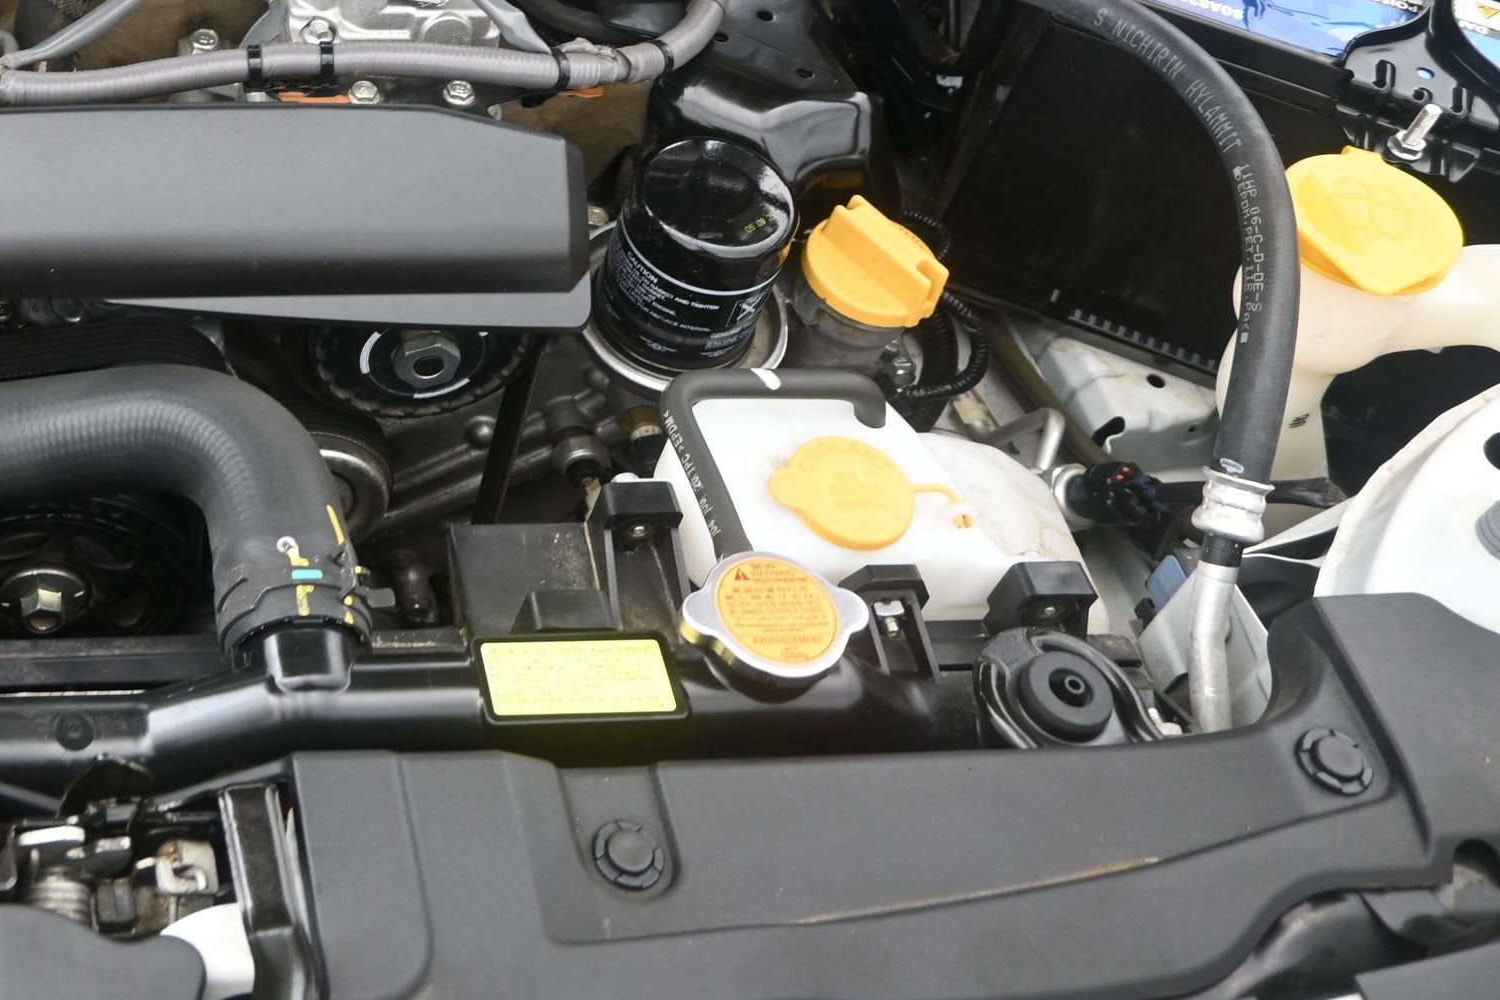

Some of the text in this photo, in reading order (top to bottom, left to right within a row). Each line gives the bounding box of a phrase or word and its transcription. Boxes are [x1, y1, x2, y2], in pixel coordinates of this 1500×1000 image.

[1112, 17, 1186, 80] NICHIRIN
[1185, 78, 1242, 153] HYLAMMIT
[627, 251, 658, 284] CAUTION
[674, 297, 690, 305] AND
[690, 301, 720, 310] TIGHTEN
